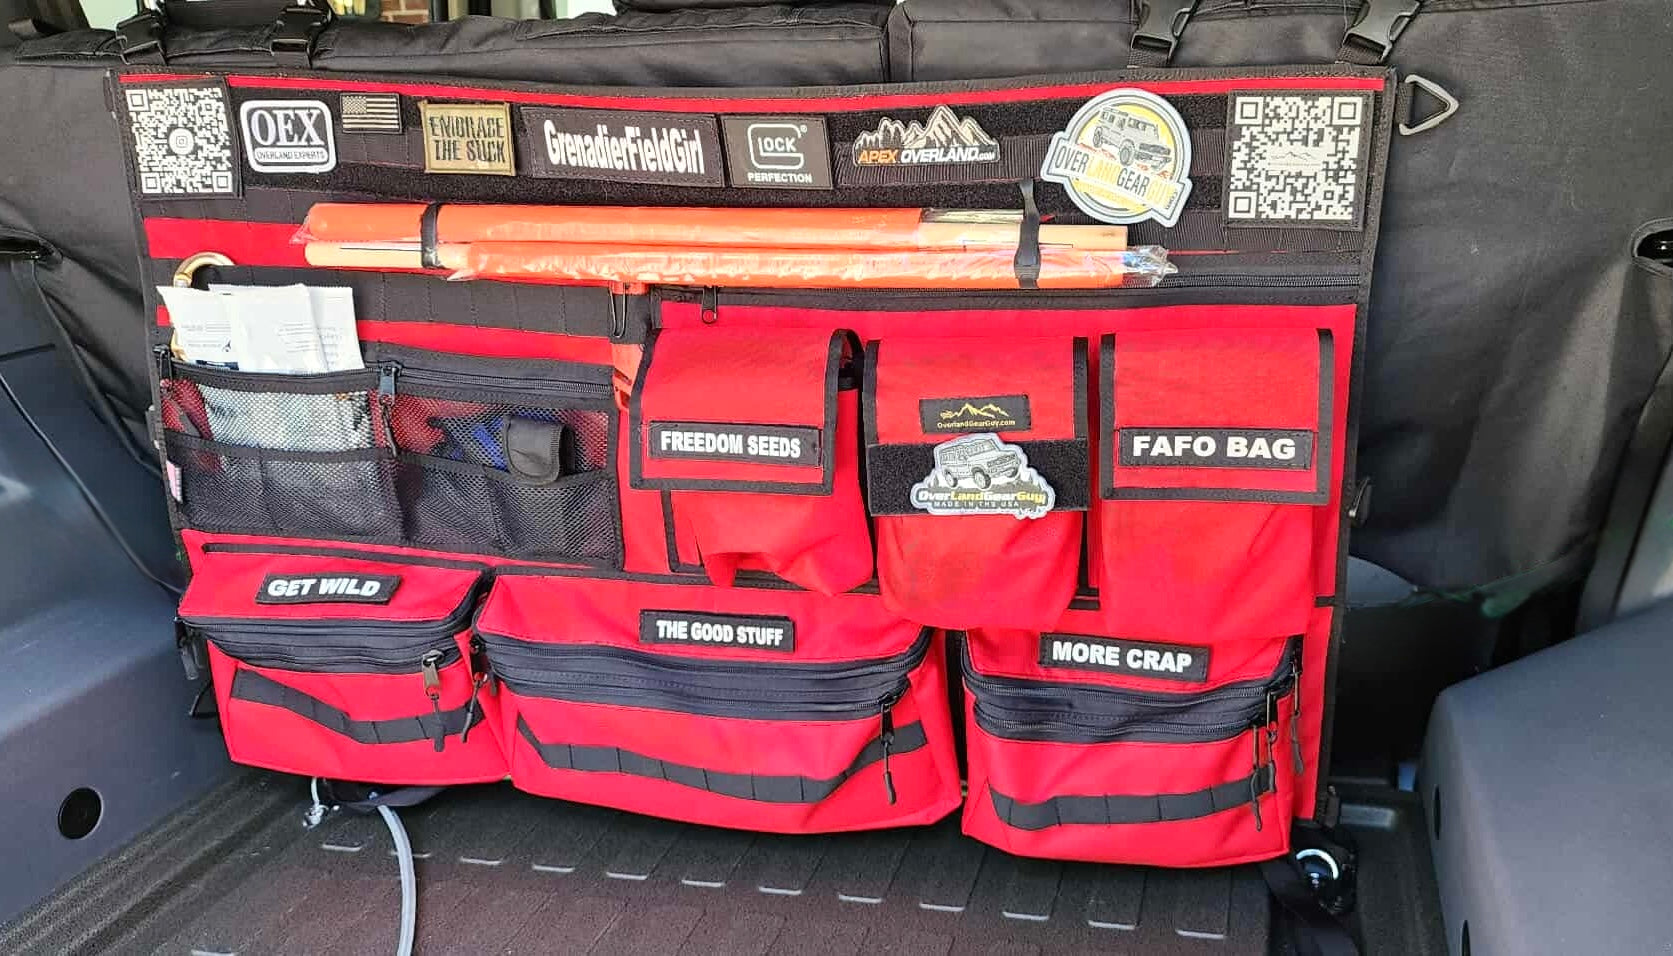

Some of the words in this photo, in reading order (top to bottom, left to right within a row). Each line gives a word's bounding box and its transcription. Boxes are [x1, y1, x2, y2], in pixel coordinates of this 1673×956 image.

[251, 109, 323, 146] OEX
[429, 115, 504, 138] EMBRACE
[257, 151, 291, 160] OVERLAND
[293, 151, 325, 160] EXPERTS
[434, 139, 464, 162] THE
[466, 141, 506, 163] SUCK
[544, 119, 705, 175] GrenadierFieldGirl
[858, 148, 898, 164] APEX
[747, 172, 812, 183] PERFECTION
[937, 419, 1016, 428] OverlandGearGuy.com
[660, 430, 743, 454] FREEDOM
[747, 435, 801, 458] SEEDS
[1132, 435, 1217, 458] FAFO
[1227, 436, 1297, 460] BAG
[918, 491, 1046, 505] OverLandGearGuy
[934, 500, 960, 508] MADE
[964, 500, 973, 508] IN
[1000, 500, 1020, 508] USA
[267, 578, 317, 596] GET
[319, 577, 380, 596] WILD
[656, 620, 688, 640] THE
[691, 623, 733, 643] GOOD
[736, 626, 783, 646] STUFF
[1052, 641, 1120, 666] MORE
[1126, 648, 1193, 673] CRAP
